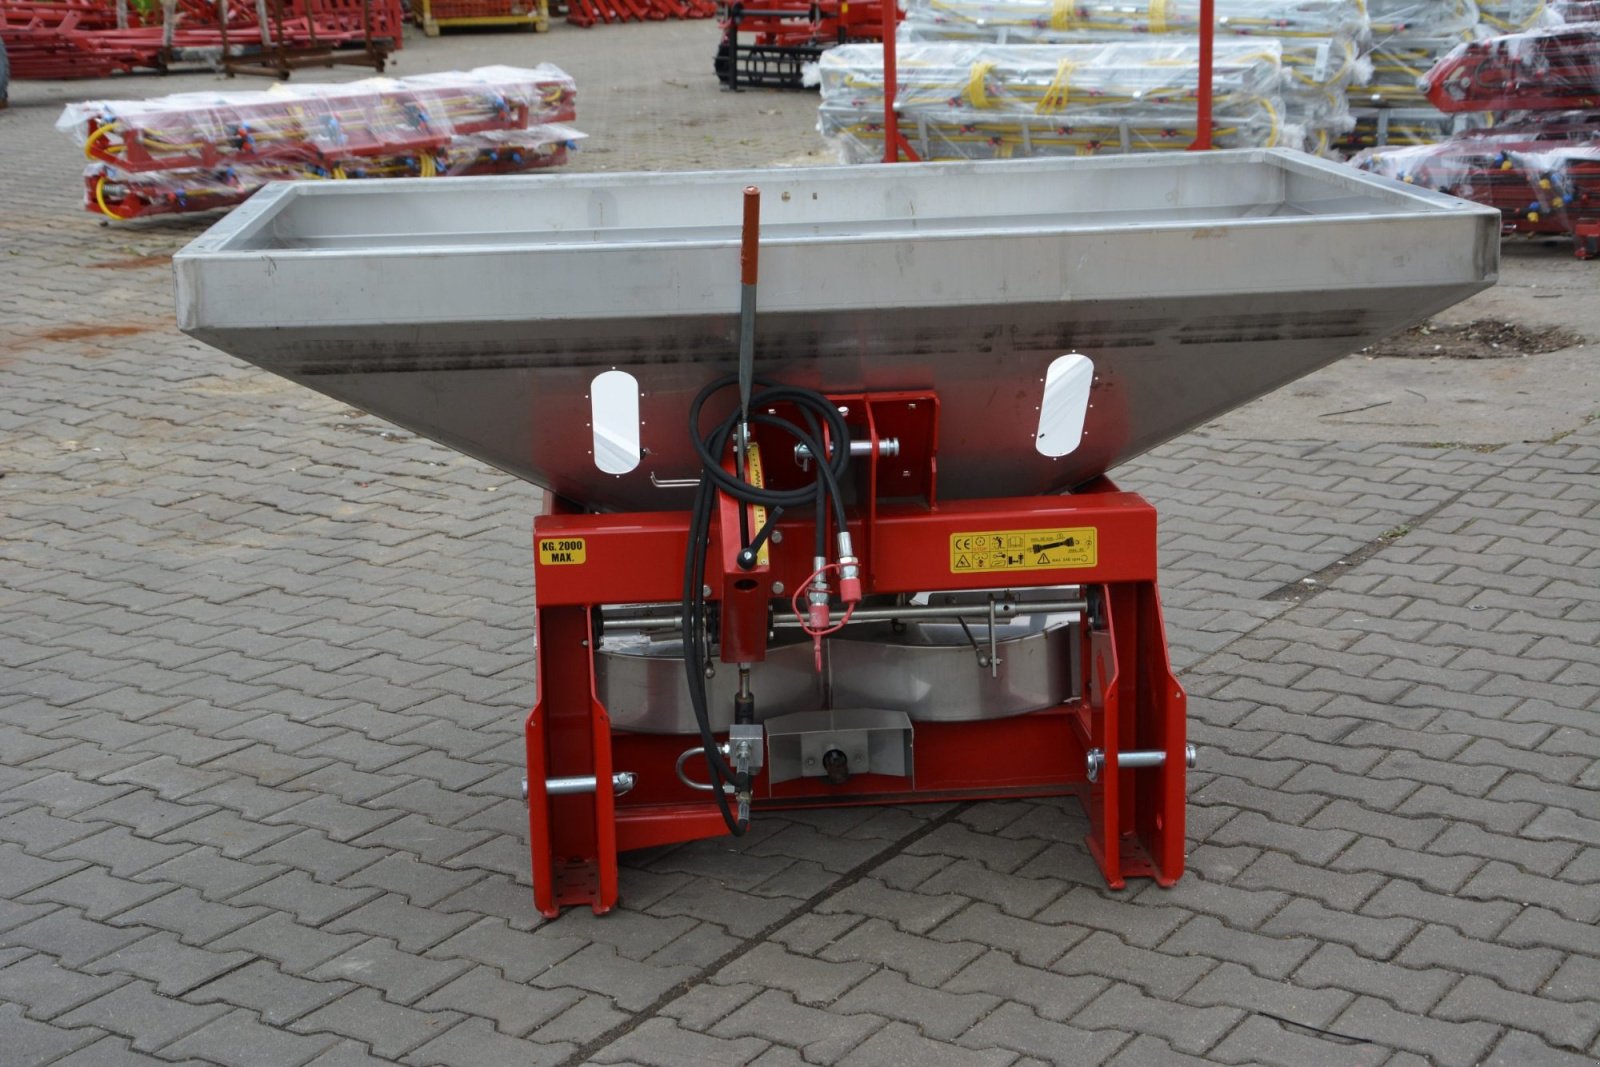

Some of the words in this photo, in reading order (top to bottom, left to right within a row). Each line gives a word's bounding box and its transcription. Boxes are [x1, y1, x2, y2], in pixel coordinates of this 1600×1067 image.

[542, 542, 557, 551] KG.
[558, 541, 583, 551] 2000
[551, 553, 574, 562] MAX.
